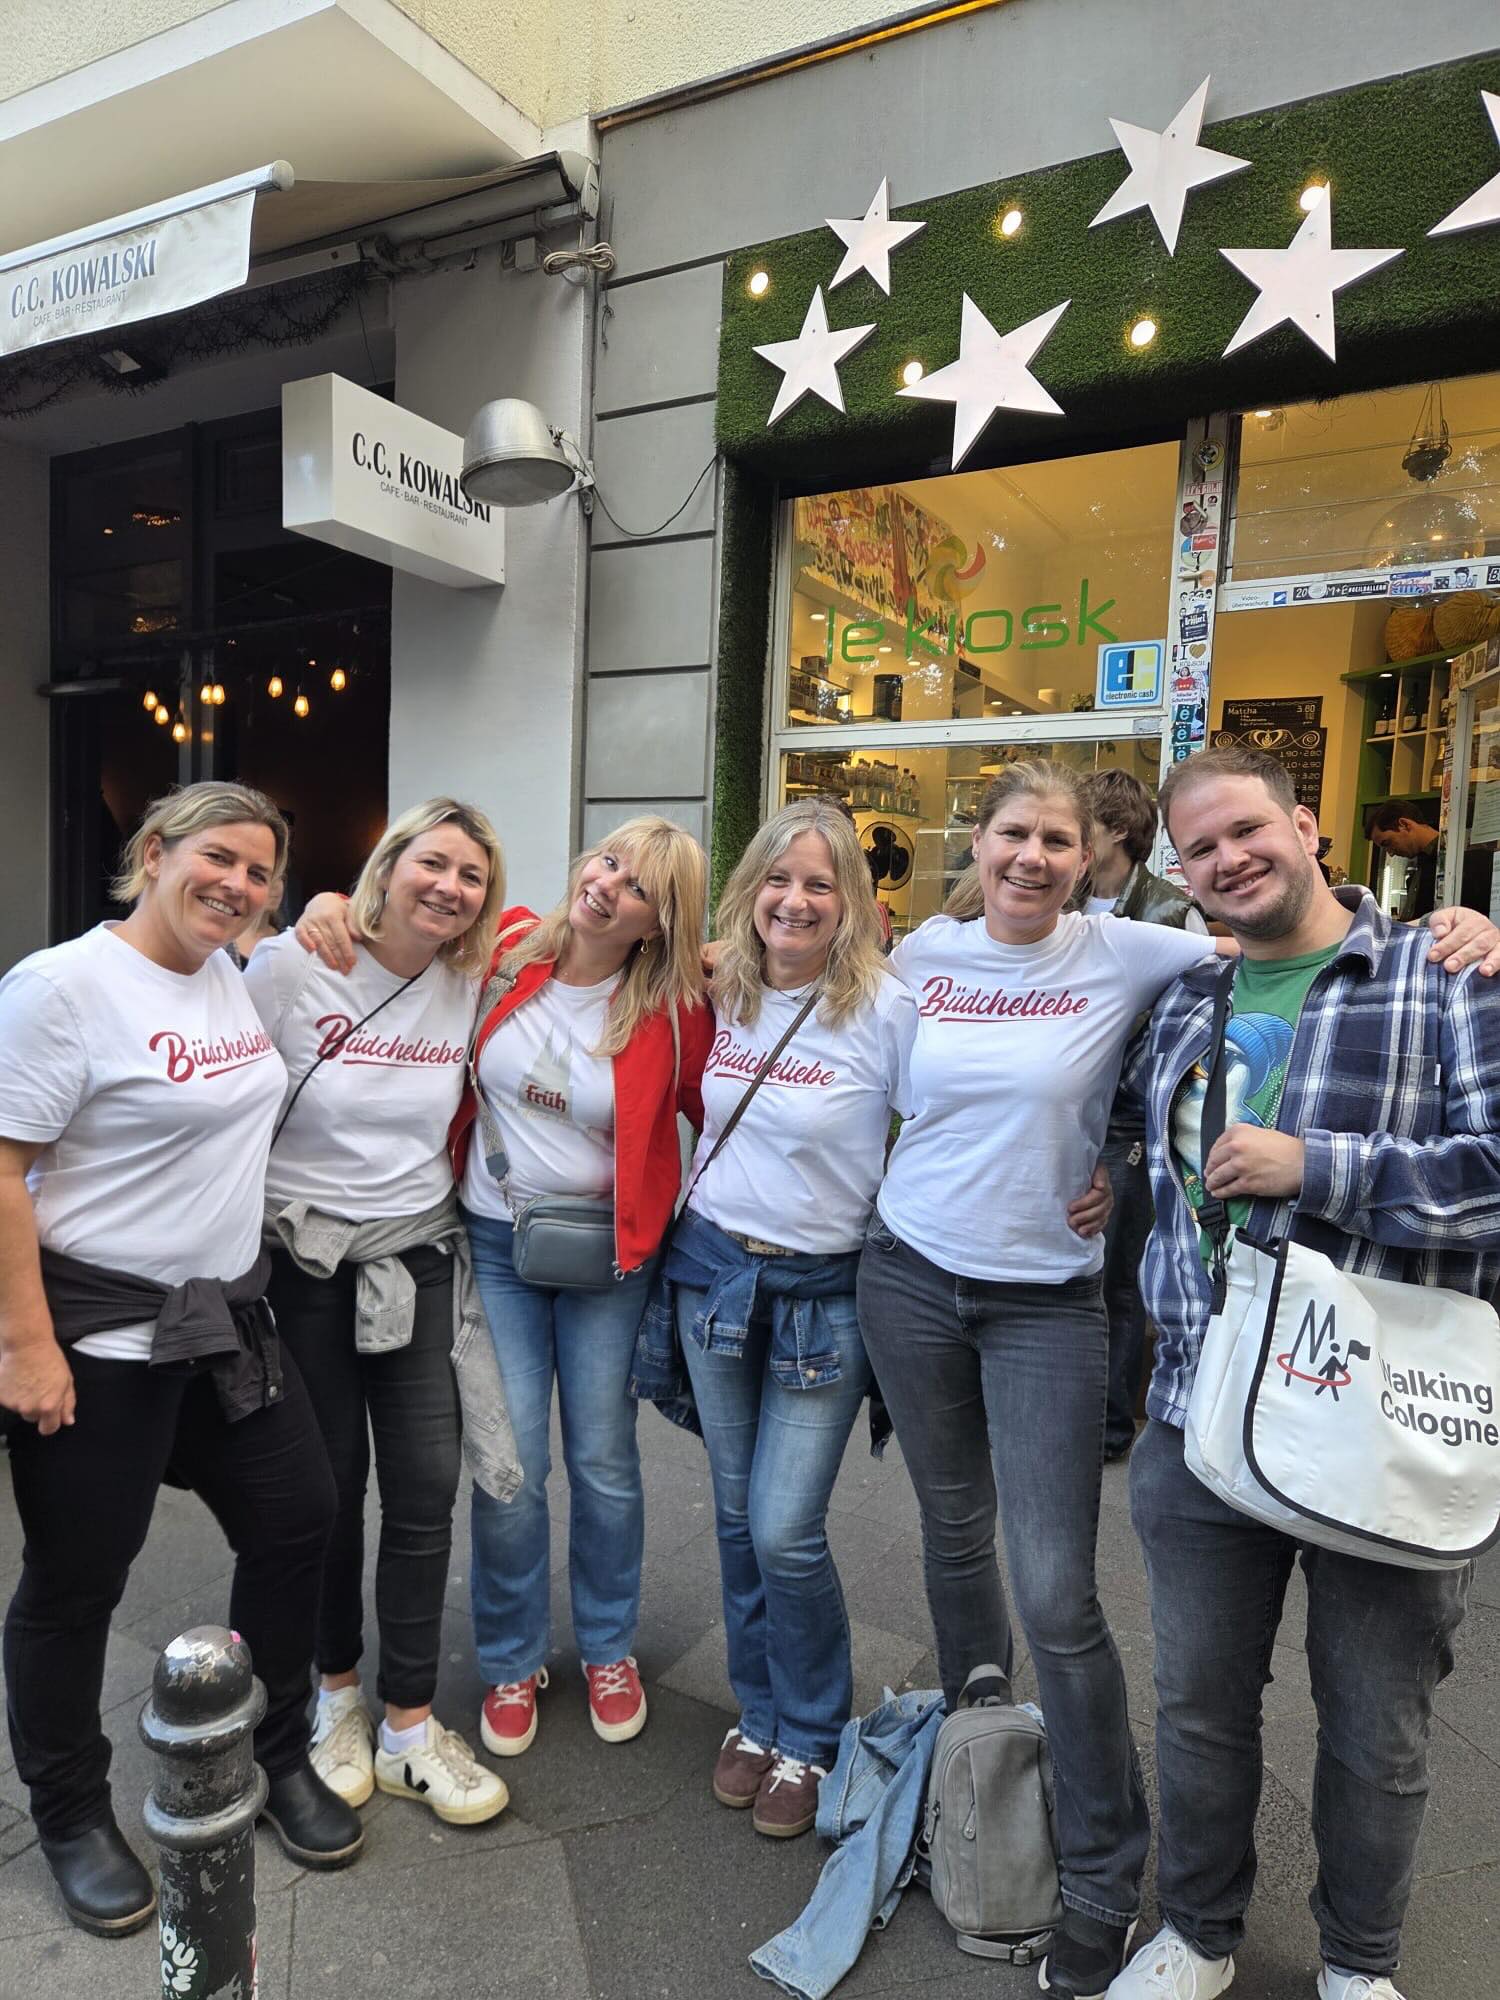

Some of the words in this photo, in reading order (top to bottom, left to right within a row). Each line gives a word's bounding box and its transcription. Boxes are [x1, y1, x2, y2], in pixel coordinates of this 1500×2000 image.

[11, 277, 44, 319] C.C.
[52, 239, 156, 305] KOWALSKI
[352, 432, 391, 479] C.C.
[827, 605, 885, 665] le
[905, 578, 1119, 658] kiosk
[1105, 690, 1137, 700] electronic
[1139, 689, 1154, 698] cash
[1228, 707, 1257, 715] Matcha
[919, 976, 1090, 1018] Büdcheliebe
[315, 1013, 465, 1065] Büdcheliebe
[705, 1030, 837, 1087] Büdcheliebe
[525, 1084, 566, 1113] früh
[1380, 1390, 1499, 1447] Cologne
